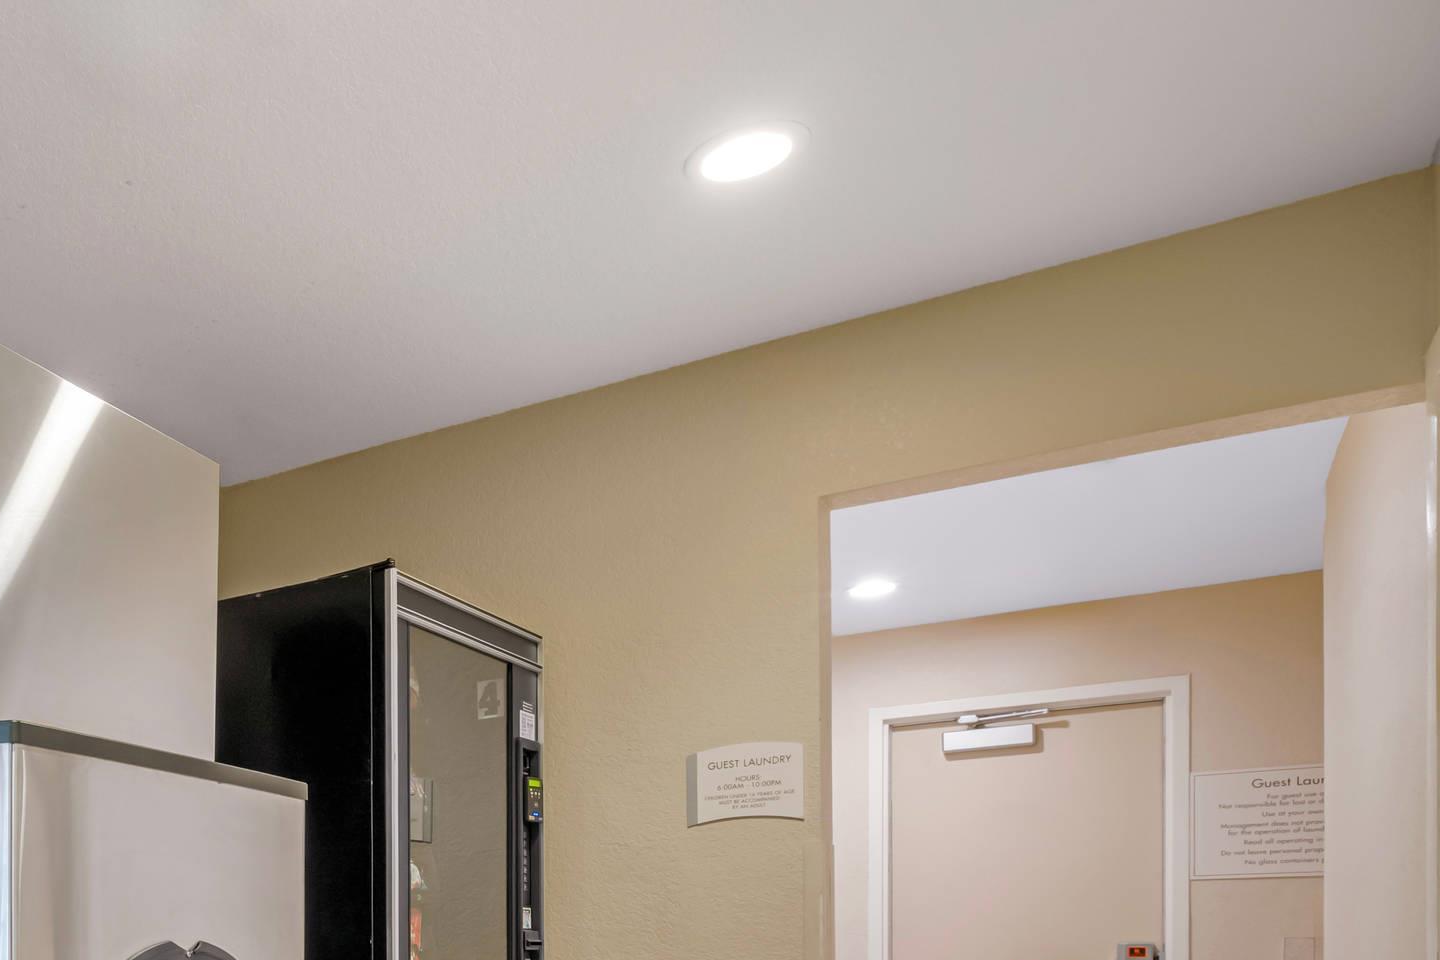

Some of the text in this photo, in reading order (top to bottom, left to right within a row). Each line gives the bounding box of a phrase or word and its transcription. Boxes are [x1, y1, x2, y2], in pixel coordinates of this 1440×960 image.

[707, 754, 792, 771] GUEST LAUNDRY
[1251, 778, 1291, 789] Guest
